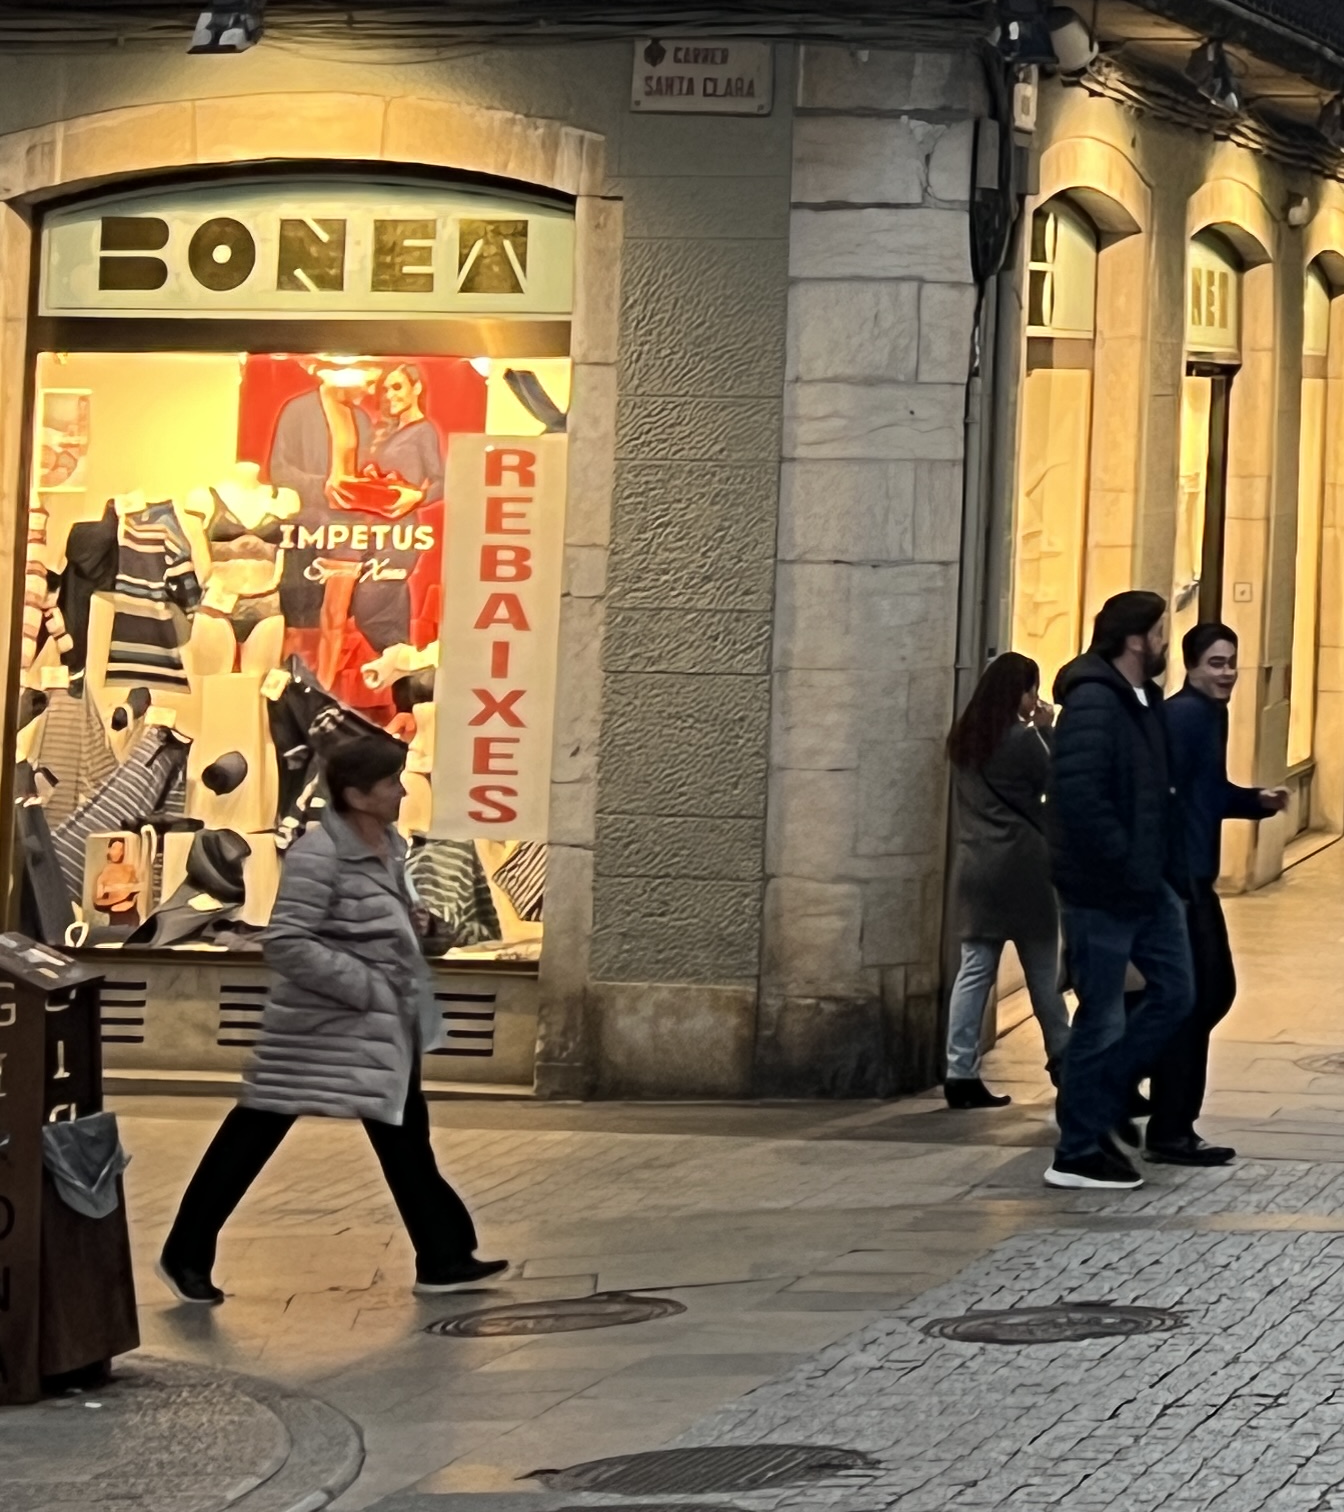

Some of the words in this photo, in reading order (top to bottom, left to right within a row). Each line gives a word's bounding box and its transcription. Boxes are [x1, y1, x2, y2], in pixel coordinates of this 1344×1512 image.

[673, 47, 729, 65] CARRER
[644, 76, 695, 96] SANTA
[702, 77, 756, 98] CLARA
[98, 216, 529, 294] BONEA
[278, 523, 435, 551] IMPETUS
[467, 447, 536, 824] REBAIXES
